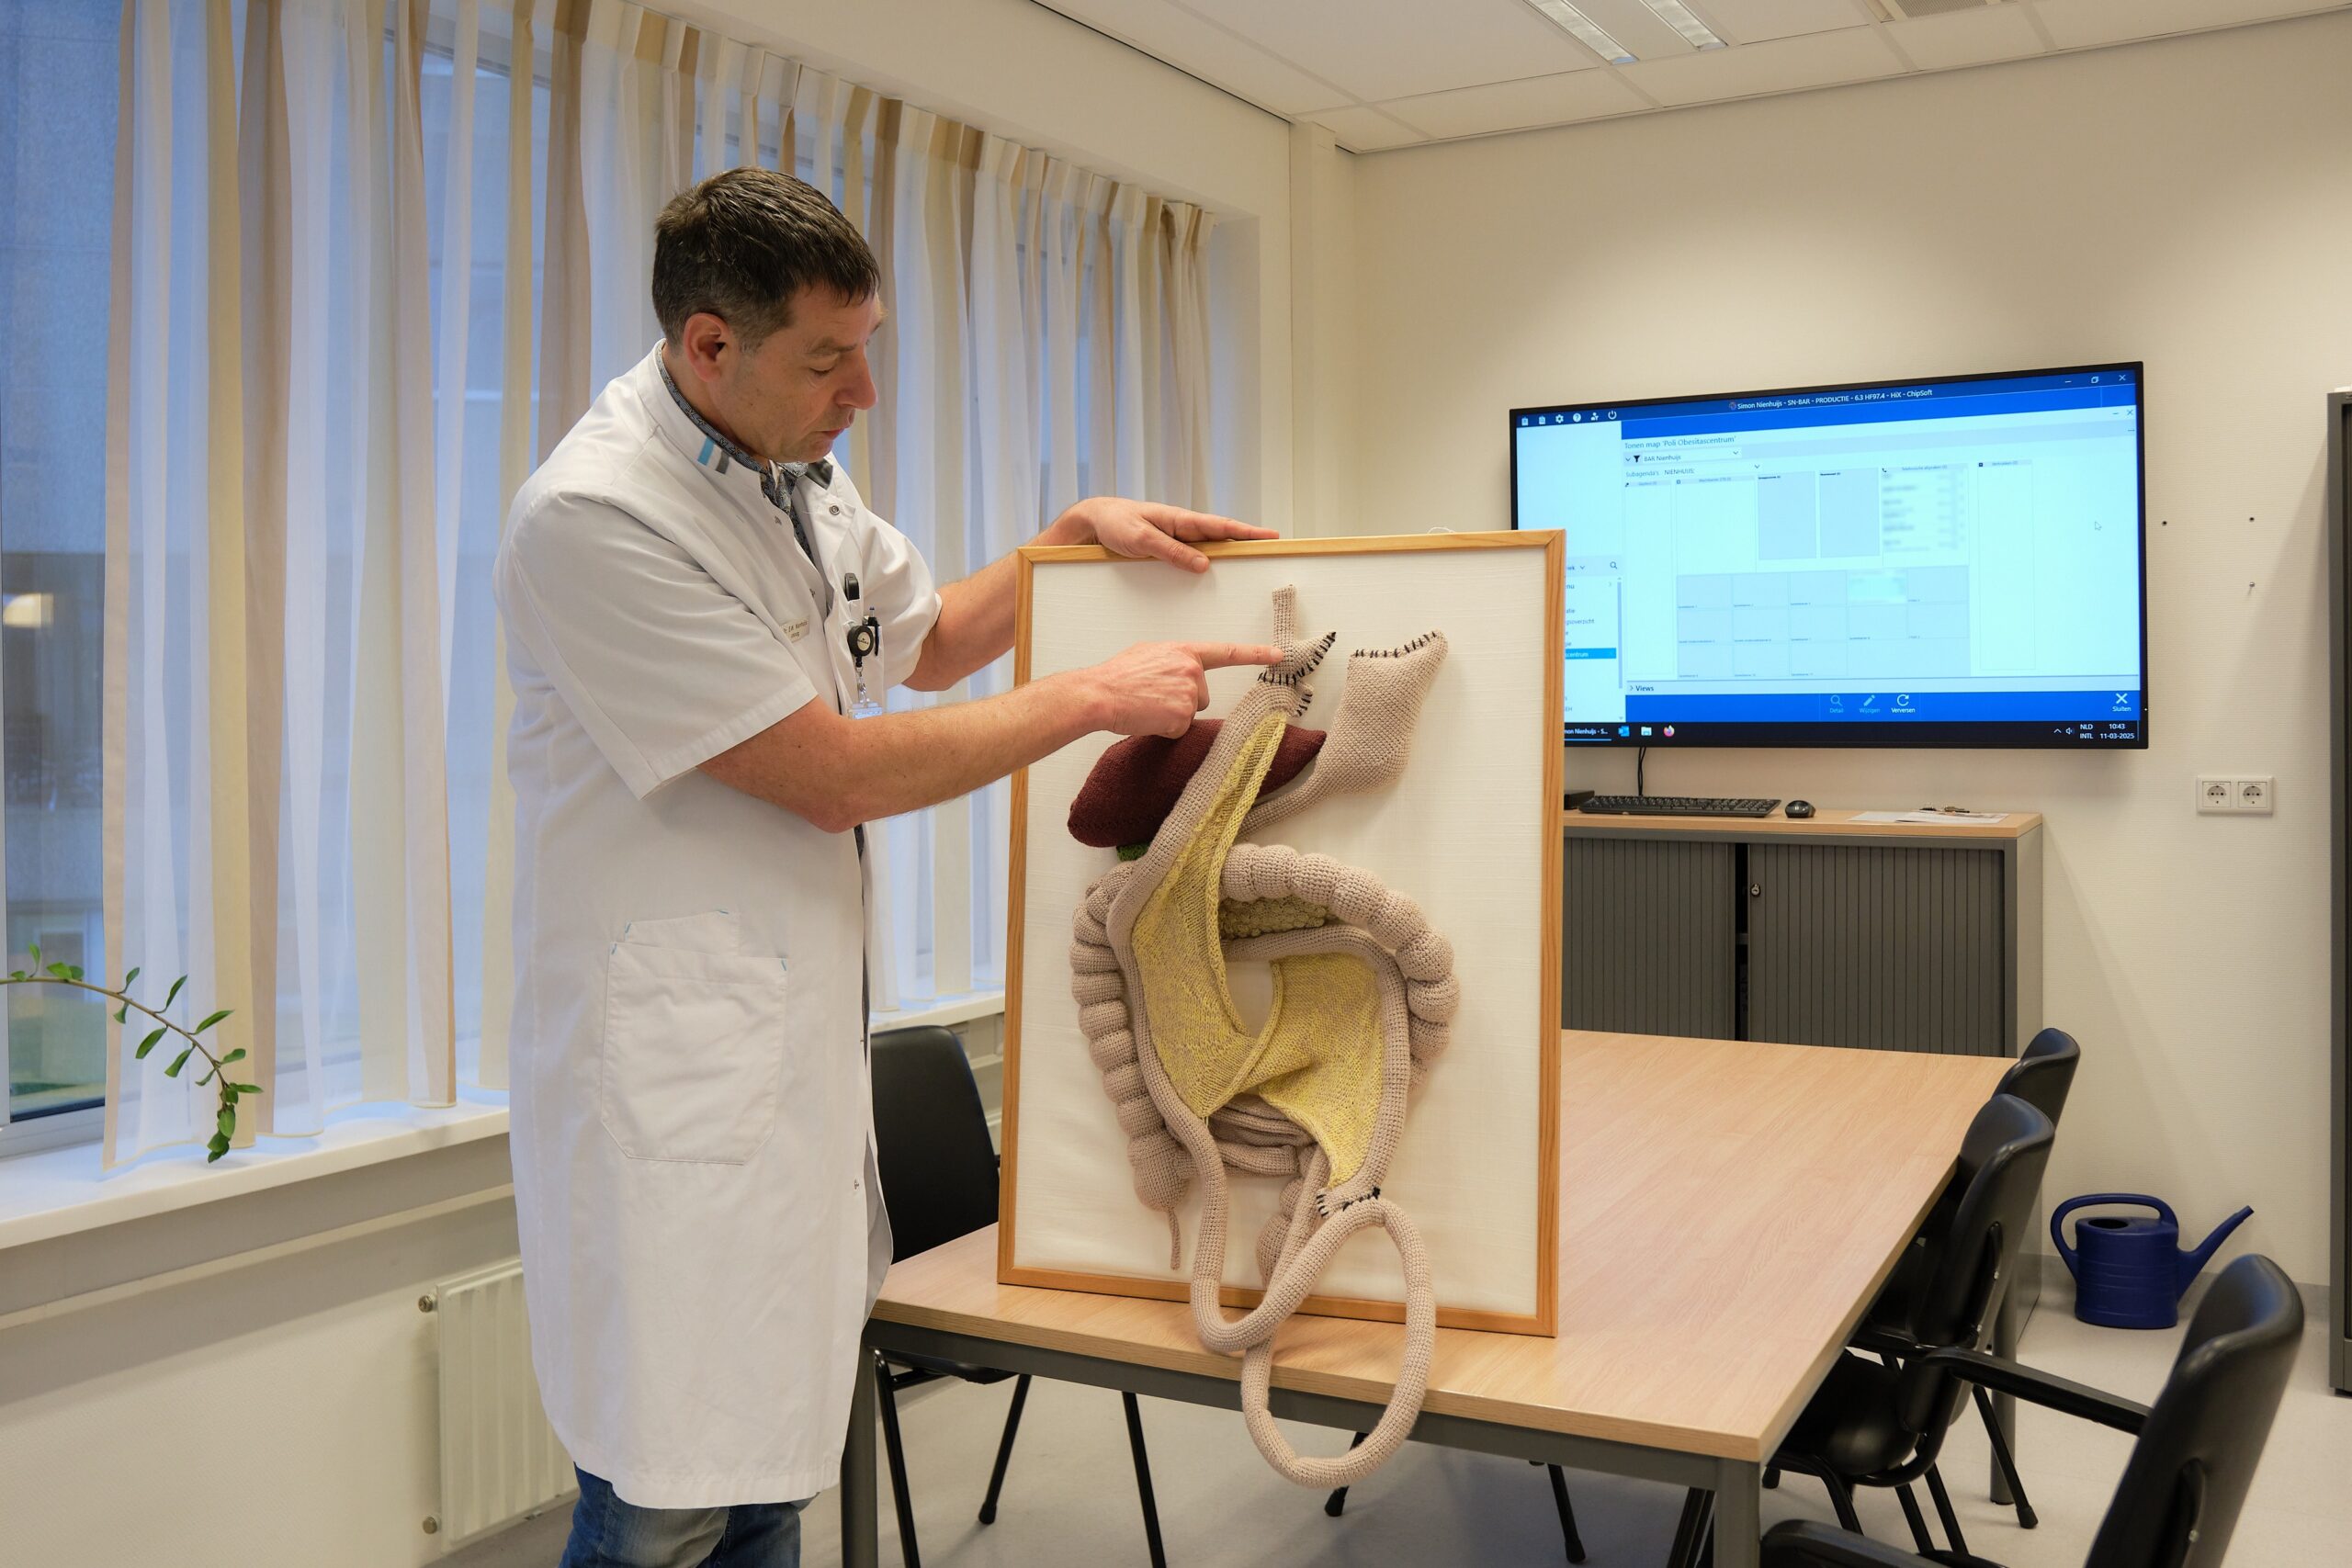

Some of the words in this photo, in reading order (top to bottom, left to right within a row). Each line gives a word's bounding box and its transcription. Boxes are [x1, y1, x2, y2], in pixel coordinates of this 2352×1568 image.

[1756, 400, 1782, 409] Nienhuijs
[1787, 398, 1811, 406] SN-BAR
[1815, 395, 1849, 404] PRODUCTIE
[1906, 389, 1933, 398] ChipSoft
[1678, 435, 1736, 446] Obesitascentrum'
[1656, 454, 1681, 462] Nienhuijs
[1575, 728, 1597, 736] Nienhuijs
